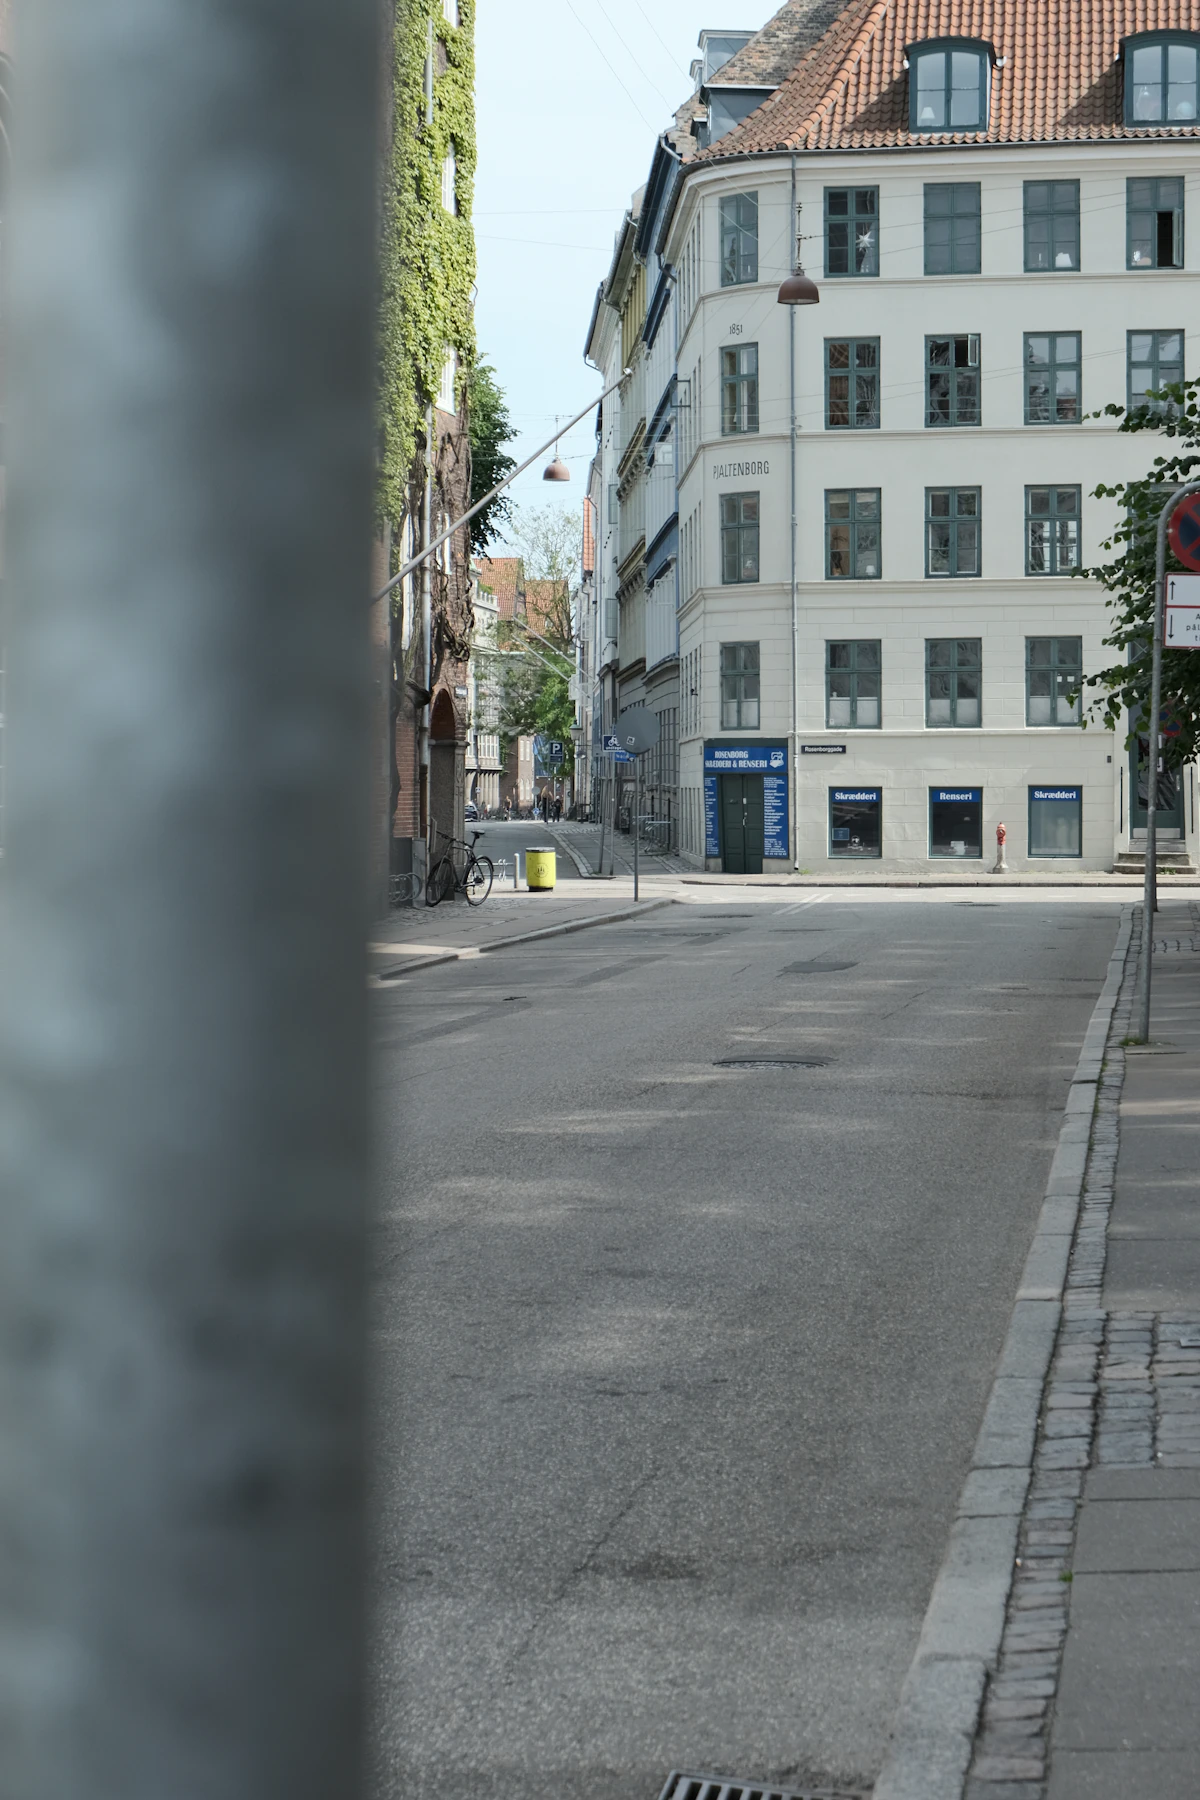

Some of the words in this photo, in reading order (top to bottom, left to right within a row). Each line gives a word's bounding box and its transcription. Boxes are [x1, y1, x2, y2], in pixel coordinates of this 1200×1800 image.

[729, 323, 743, 335] 1851
[712, 461, 770, 480] PJALTENBORG
[552, 743, 561, 754] P
[715, 750, 749, 759] ROSENBORG
[732, 760, 738, 768] &
[739, 760, 767, 768] RENSERI
[835, 792, 877, 801] Skrædderi
[939, 792, 973, 801] Renseri
[1034, 790, 1077, 799] Skrædderi
